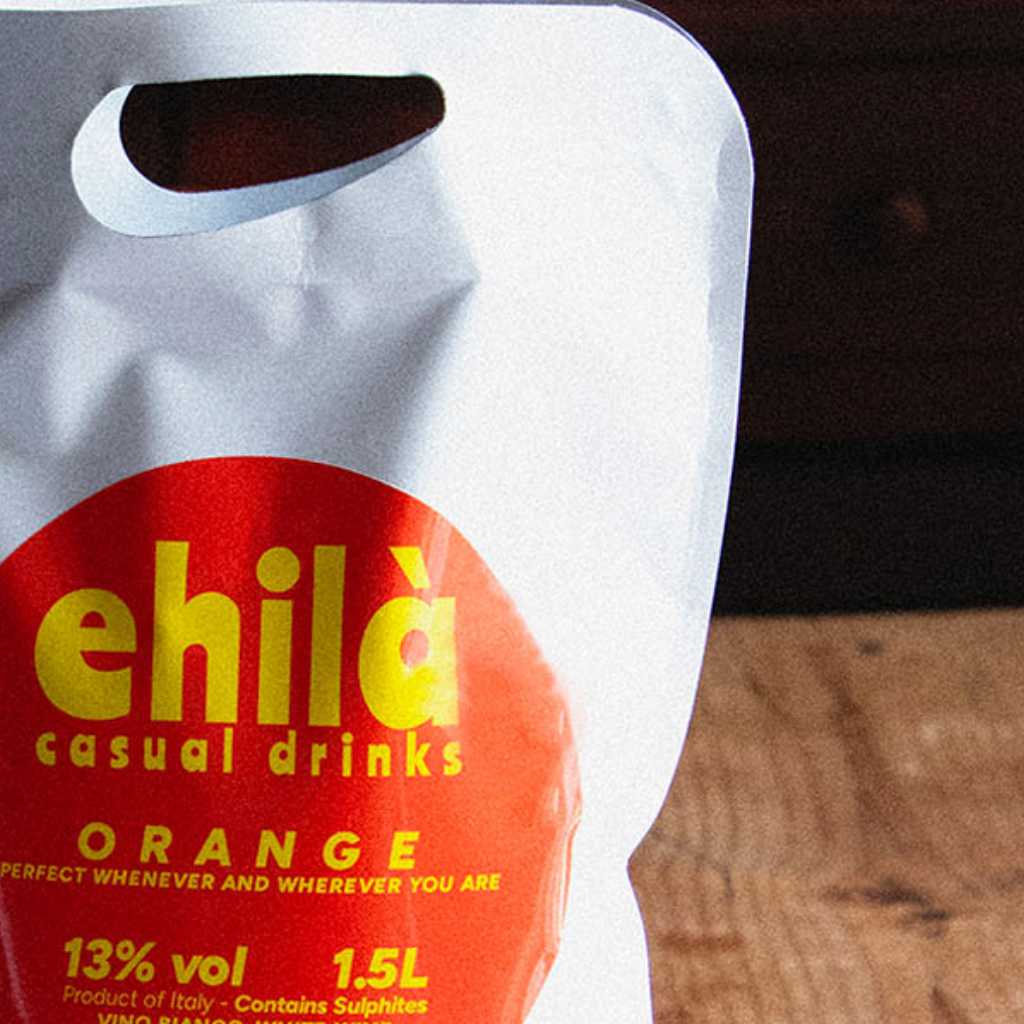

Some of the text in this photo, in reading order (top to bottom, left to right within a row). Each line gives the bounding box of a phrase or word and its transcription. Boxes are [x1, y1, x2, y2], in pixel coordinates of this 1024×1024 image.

[35, 540, 459, 730] ehilà
[36, 727, 464, 778] casual drinks
[78, 821, 421, 871] ORANGE
[0, 861, 502, 895] PERFECT WHENEVER AND WHEREVER YOU ARE
[64, 937, 429, 990] 13% vol 1.5L
[63, 985, 137, 1008] Product
[143, 990, 167, 1009] of
[170, 991, 215, 1016] Italy
[234, 994, 328, 1015] Contains
[333, 996, 429, 1019] Sulphites
